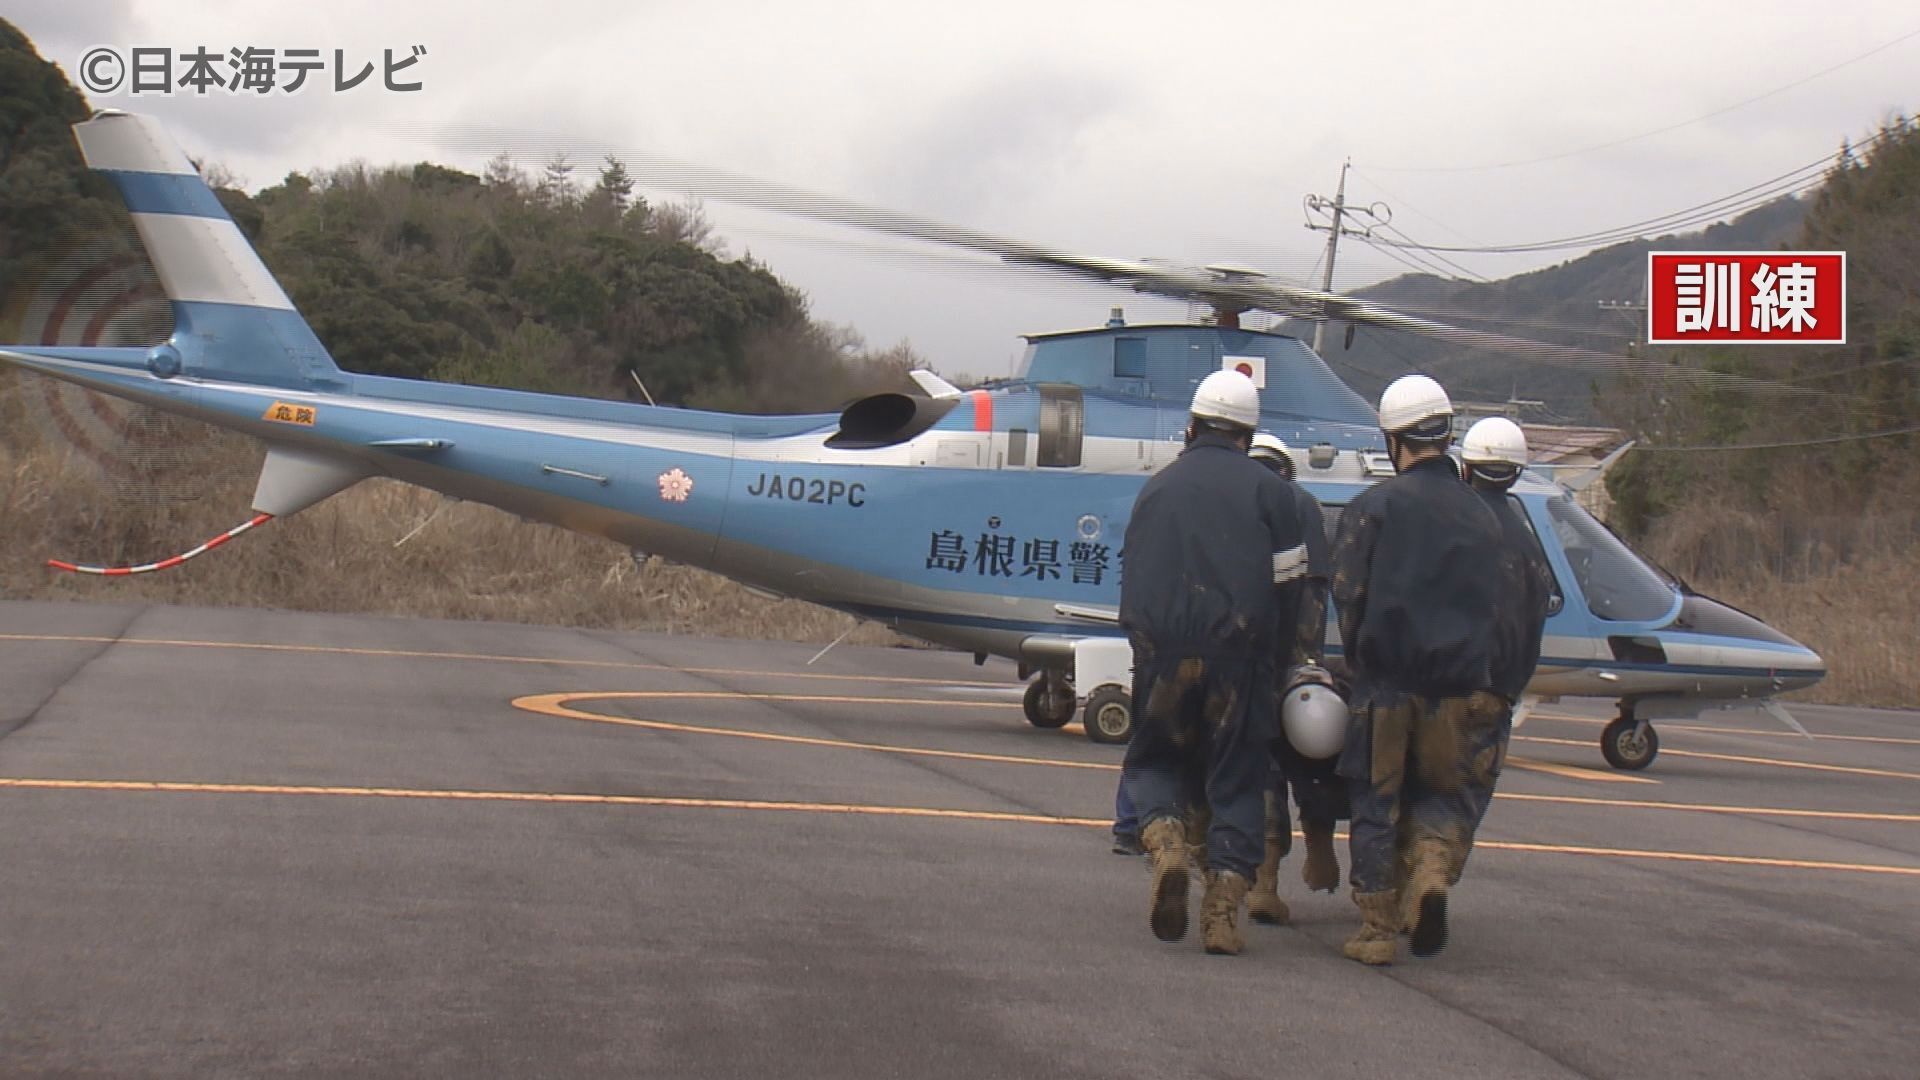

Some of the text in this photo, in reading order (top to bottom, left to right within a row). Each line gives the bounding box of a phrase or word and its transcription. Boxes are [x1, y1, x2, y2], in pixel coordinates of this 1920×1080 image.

[275, 405, 313, 424] 危険
[747, 472, 866, 508] JA02PC
[925, 529, 1122, 586] 島根県警
